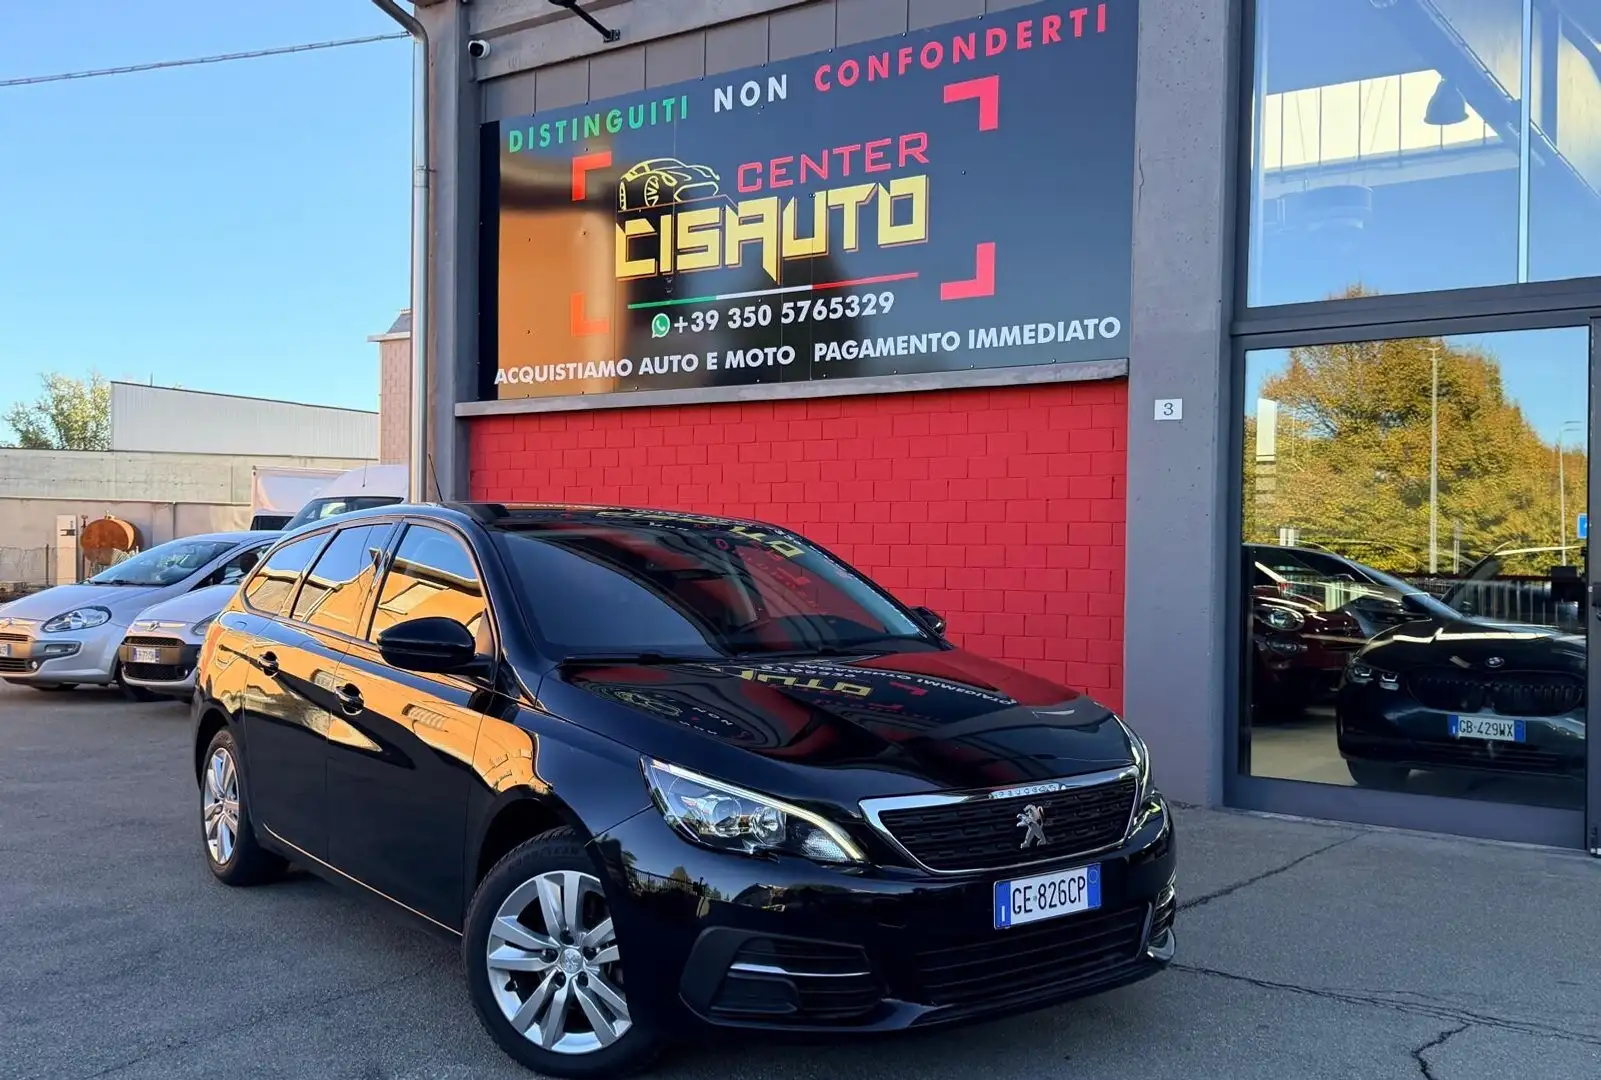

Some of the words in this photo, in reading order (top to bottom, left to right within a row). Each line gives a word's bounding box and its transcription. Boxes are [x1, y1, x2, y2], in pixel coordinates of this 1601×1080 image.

[509, 95, 688, 153] DISTINGUITI
[713, 74, 788, 113] NON
[814, 3, 1106, 92] CONFONDERTI
[737, 131, 929, 193] CENTER
[615, 174, 929, 285] CISAUTO
[674, 311, 719, 333] +39
[727, 304, 772, 329] 350
[781, 291, 895, 325] 5765329
[814, 330, 960, 362] PAGAMENTO
[968, 316, 1121, 350] IMMEDIATO
[494, 358, 633, 385] ACQUISTIAMO
[639, 352, 699, 375] AUTO
[706, 351, 718, 371] E
[724, 345, 796, 369] MOTO
[1163, 402, 1174, 416] 3
